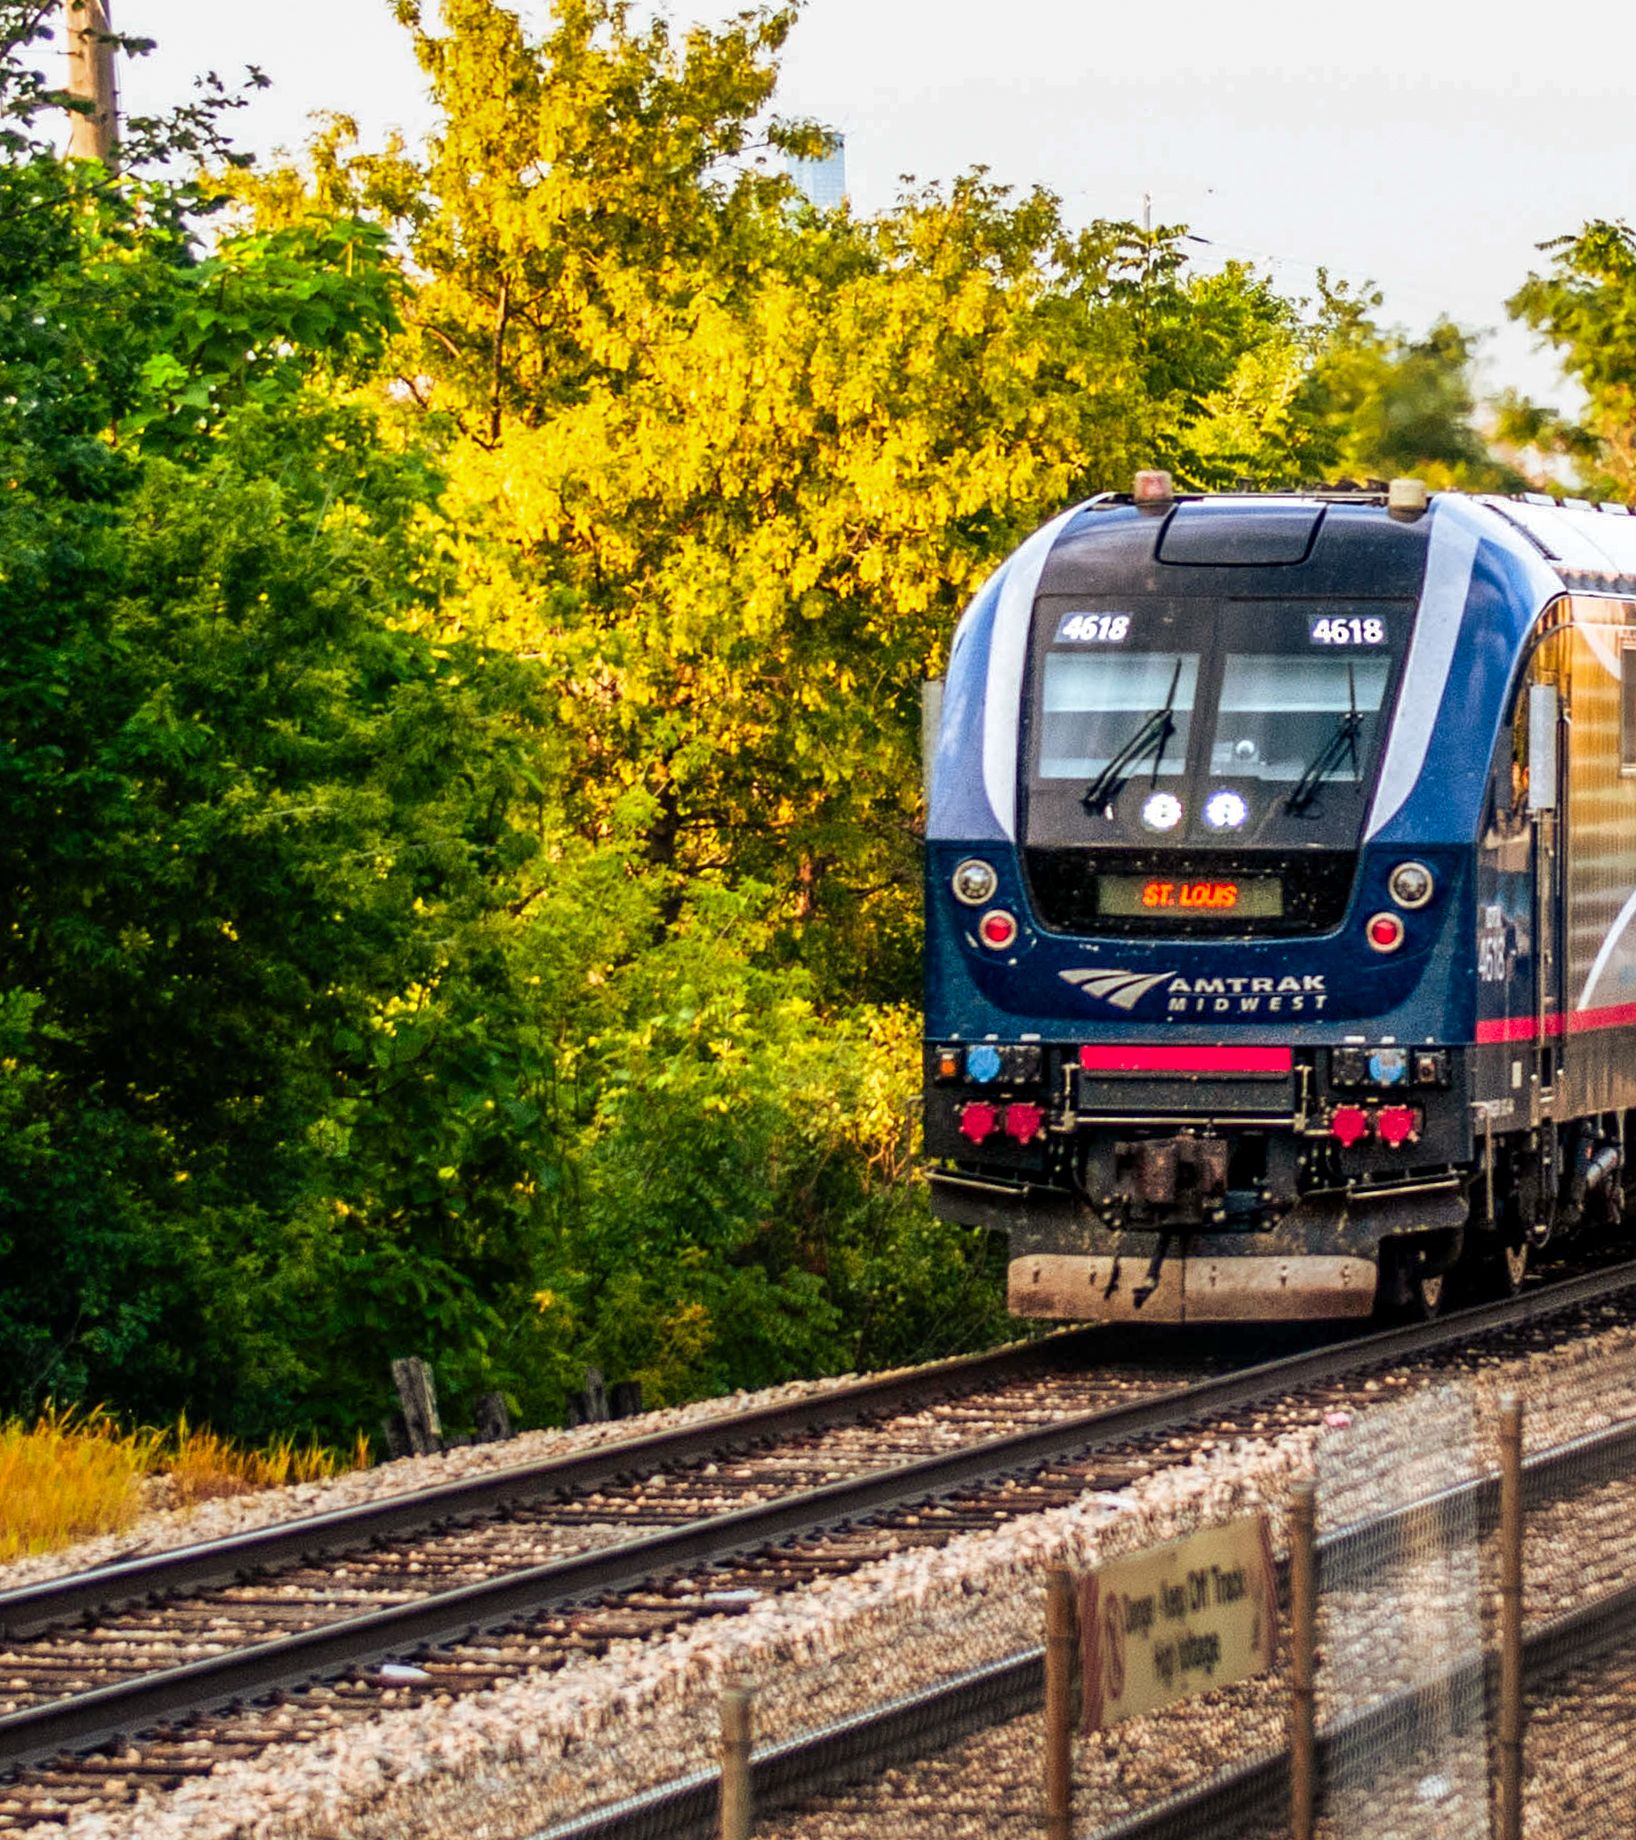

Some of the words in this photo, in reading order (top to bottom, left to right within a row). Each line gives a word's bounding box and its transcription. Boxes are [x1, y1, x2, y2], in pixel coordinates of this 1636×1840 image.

[1062, 615, 1130, 641] 4618
[1312, 618, 1384, 644] 4618
[1142, 881, 1176, 908] ST.
[1178, 881, 1239, 909] LOUIS
[1167, 974, 1326, 993] AMTRAK
[1167, 995, 1328, 1012] MIDWEST
